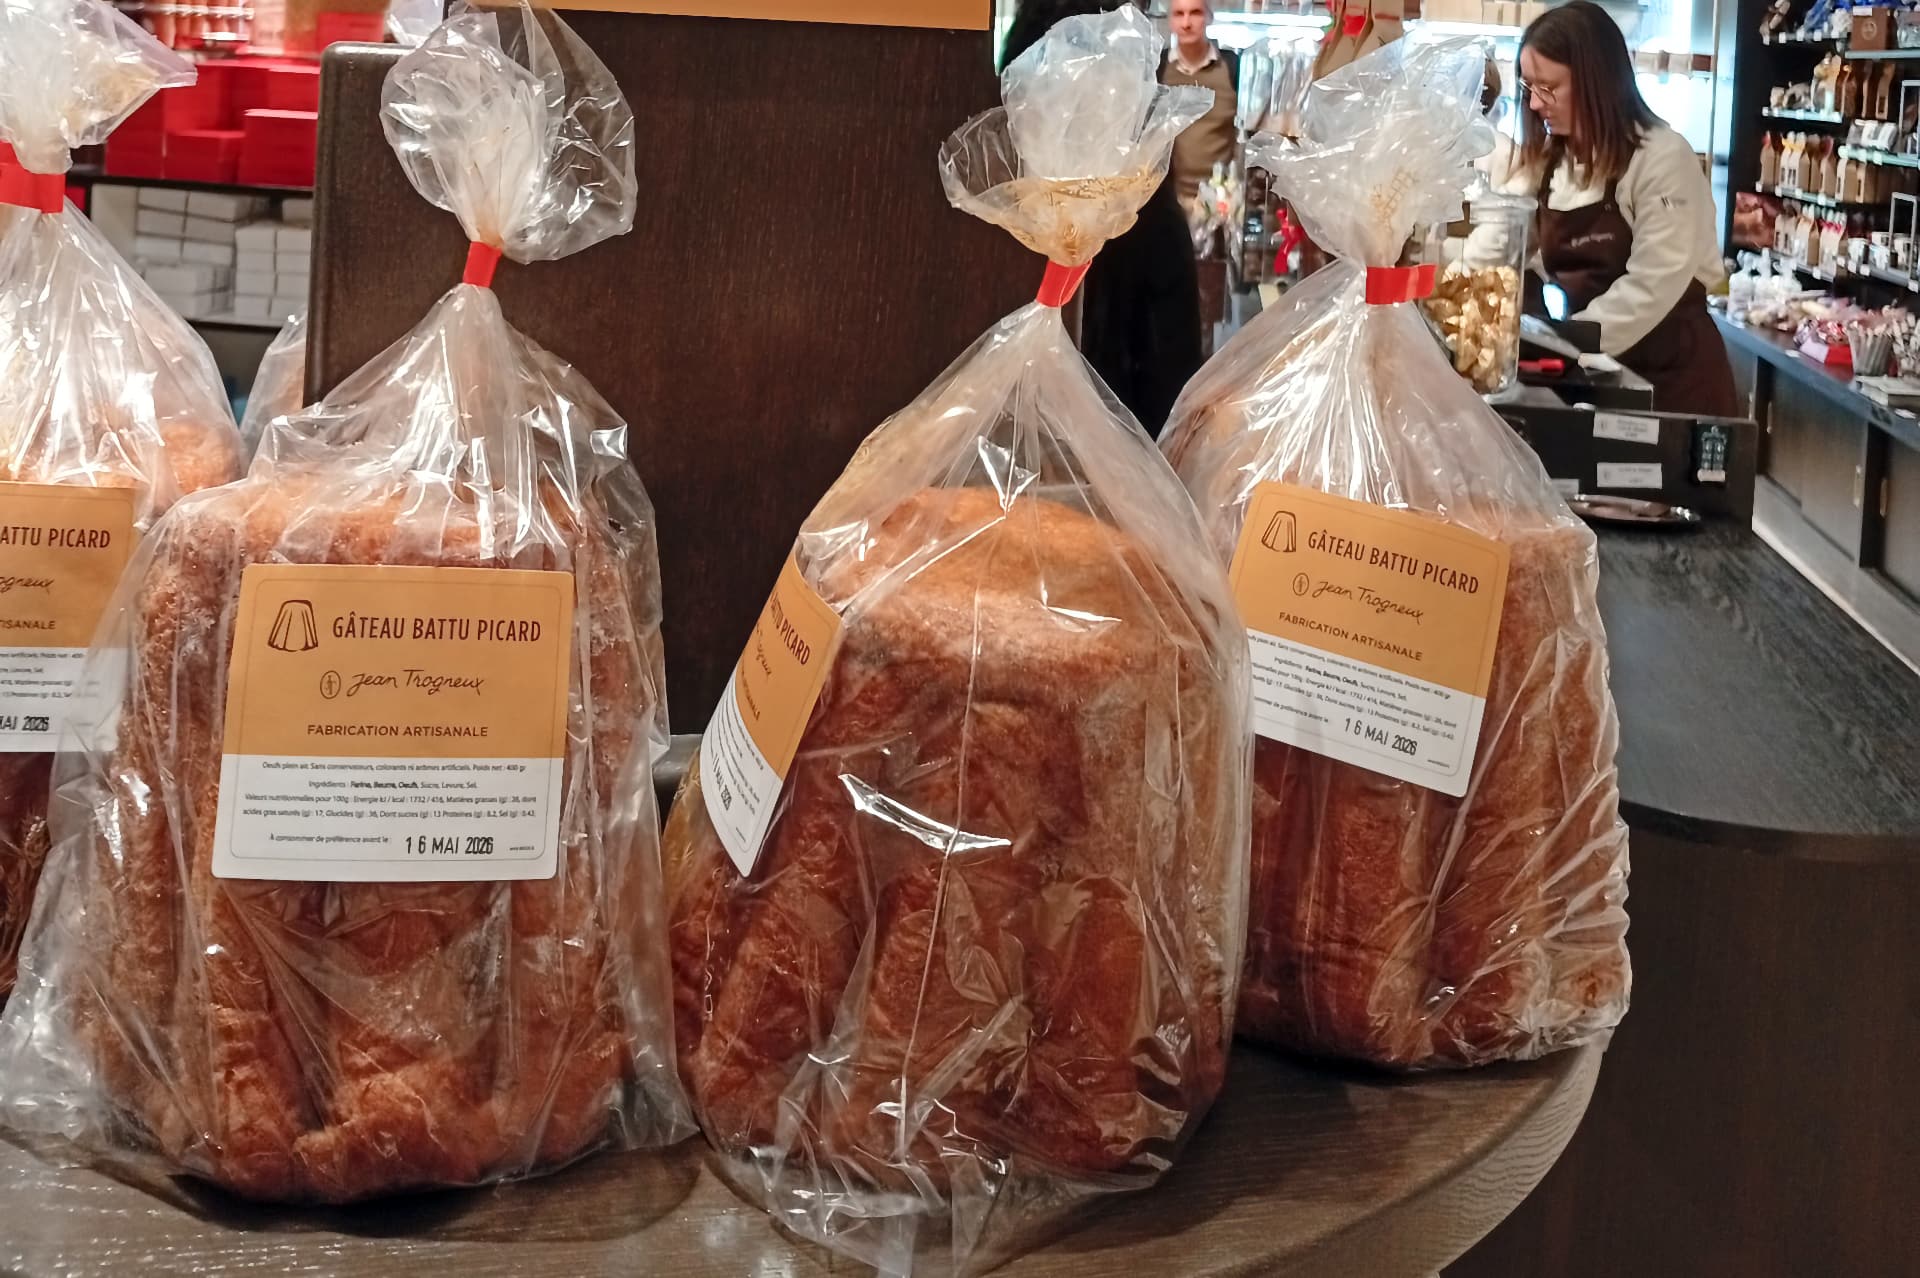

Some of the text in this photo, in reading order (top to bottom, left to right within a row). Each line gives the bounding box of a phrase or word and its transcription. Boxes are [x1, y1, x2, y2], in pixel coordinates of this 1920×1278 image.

[0, 525, 111, 548] ATTU PICARD
[1308, 529, 1479, 594] GÂTEAU BATTU PICARD
[332, 611, 541, 642] GÂTEAU BATTU PICARD
[780, 618, 810, 665] PICARD
[1279, 611, 1349, 640] FABRICATION
[1351, 633, 1423, 661] ARTISANALE
[346, 669, 484, 697] Jean Trogneux
[307, 724, 488, 738] FABRICATION ARTISANALE
[1364, 724, 1389, 746] MAI
[1391, 734, 1418, 756] 2026
[431, 837, 460, 854] MAI
[464, 836, 494, 855] 2026
